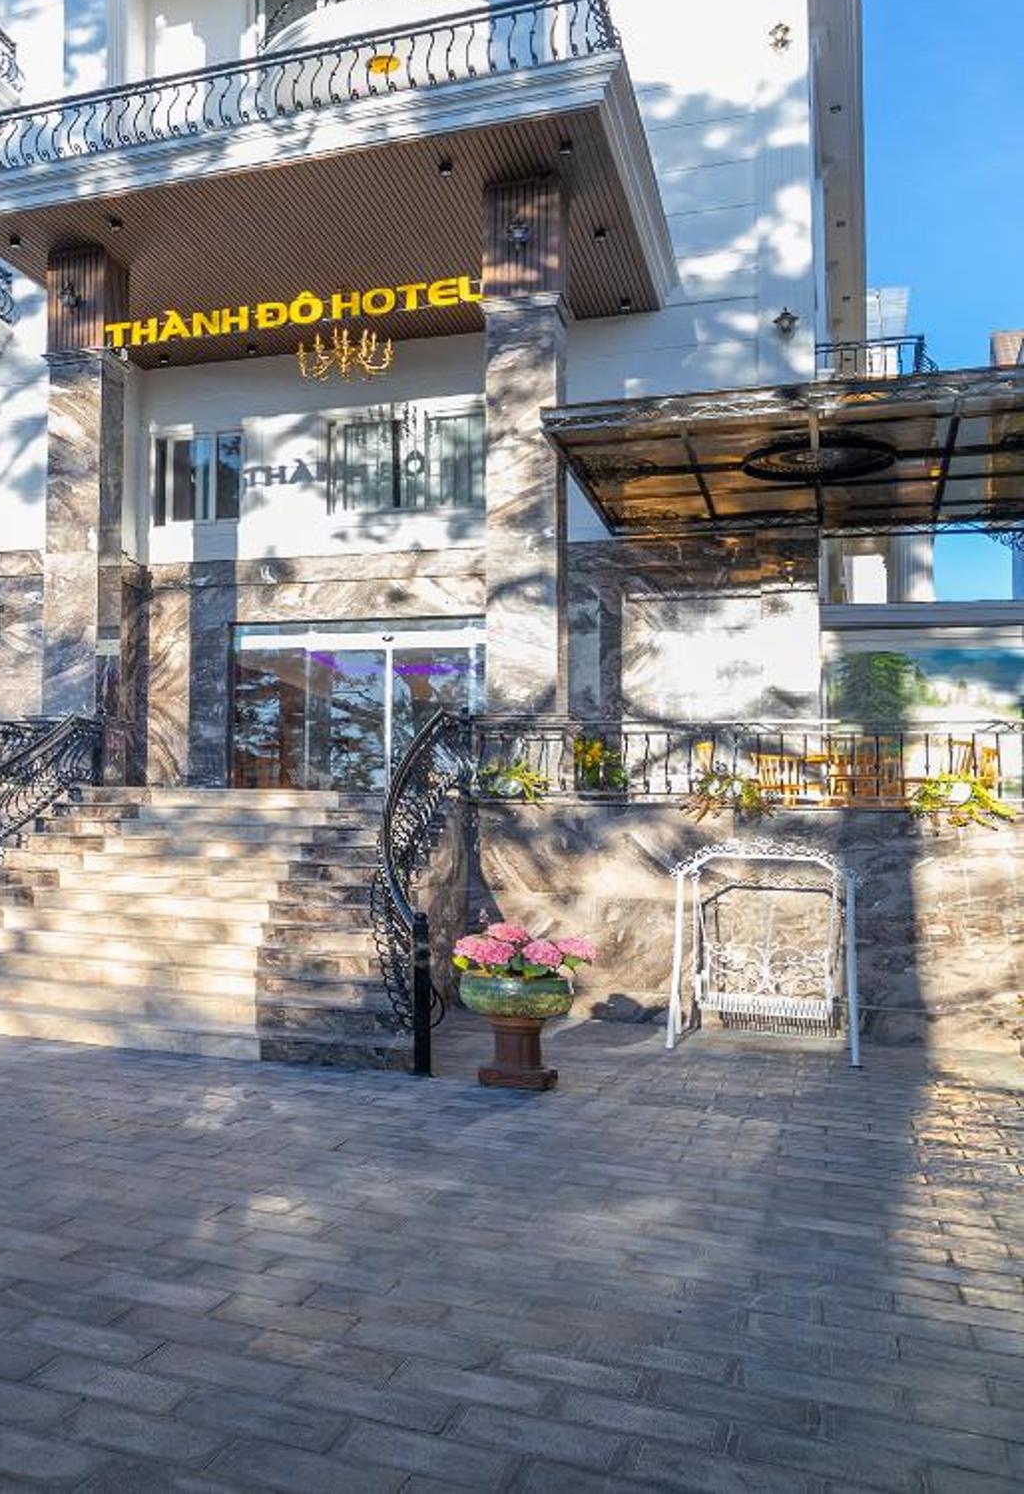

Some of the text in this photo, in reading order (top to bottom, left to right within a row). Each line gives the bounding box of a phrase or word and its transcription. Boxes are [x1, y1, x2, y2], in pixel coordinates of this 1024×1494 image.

[105, 275, 485, 347] THÀNH ĐÔ HOTEL
